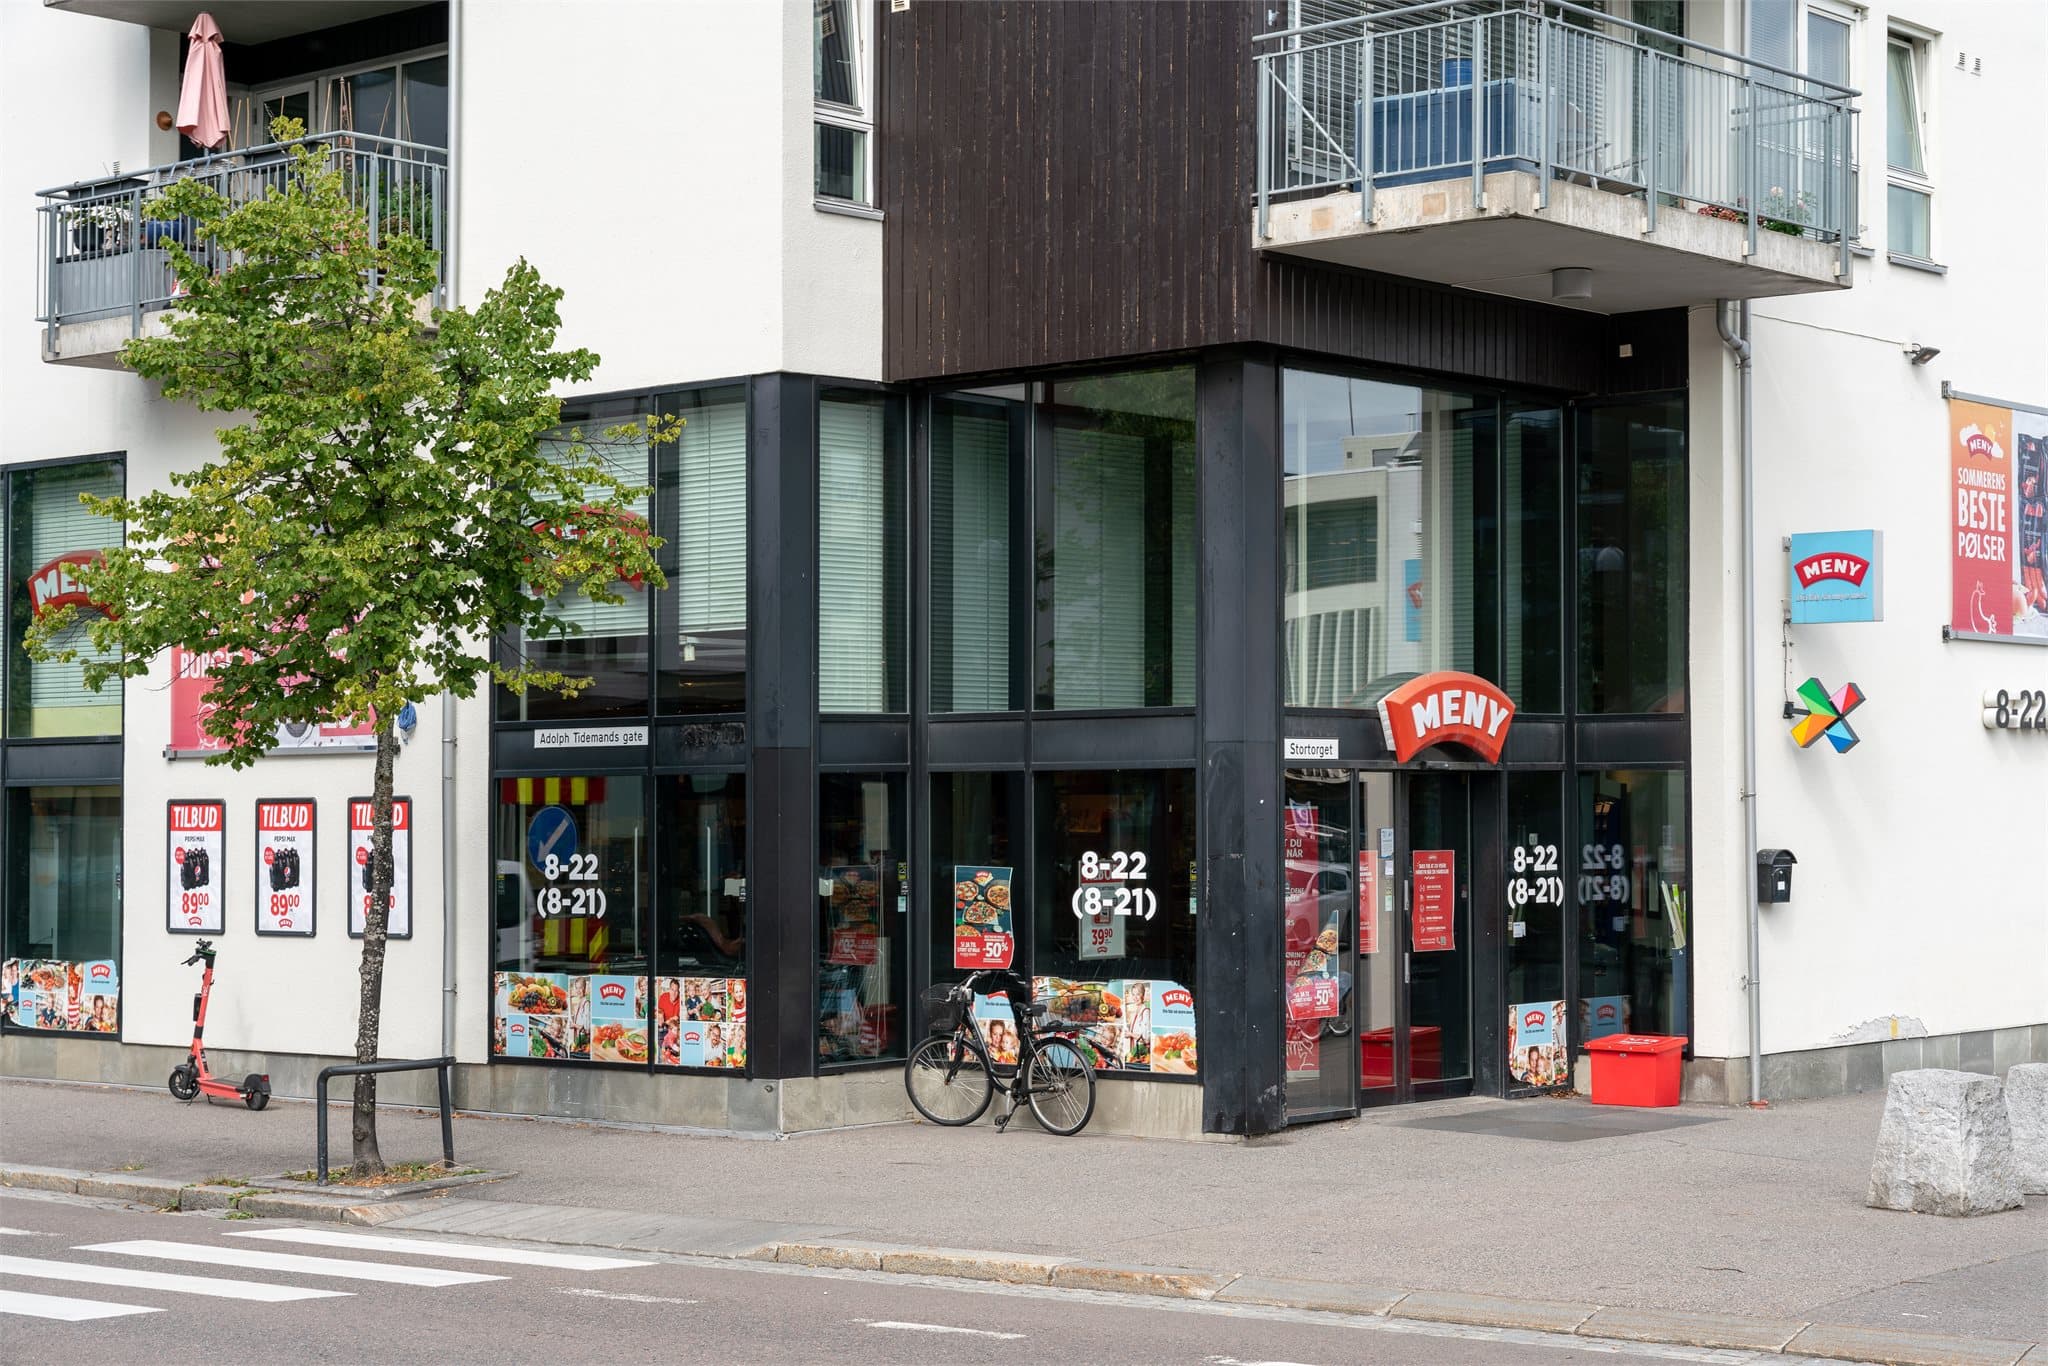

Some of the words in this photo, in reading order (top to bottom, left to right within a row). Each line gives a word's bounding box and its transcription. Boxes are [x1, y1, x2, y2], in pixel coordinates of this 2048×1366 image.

[1970, 437, 1992, 454] MENY
[1957, 467, 2006, 491] SOMMERENS
[1958, 488, 2006, 532] BESTE
[1958, 531, 2006, 562] PØLSER
[1802, 558, 1862, 580] MENY
[1411, 689, 1509, 738] MENY
[1996, 689, 2047, 729] 8-22
[540, 732, 570, 745] Adolph
[573, 731, 620, 743] Tidemands
[623, 731, 643, 744] gate
[1290, 742, 1333, 758] Stortorget
[173, 806, 218, 828] TILBUD
[262, 805, 309, 828] TILBUD
[355, 803, 403, 827] TILD
[1290, 839, 1302, 847] DU
[544, 853, 599, 881] 8-22
[1081, 851, 1147, 880] 8-22
[1513, 844, 1558, 873] 8-22
[536, 887, 607, 919] (8-21)
[1072, 887, 1157, 921] (8-21)
[1507, 876, 1564, 909] (8-21)
[602, 986, 624, 996] MENY
[1165, 993, 1191, 1003] MENY
[1526, 1013, 1544, 1024] MENY
